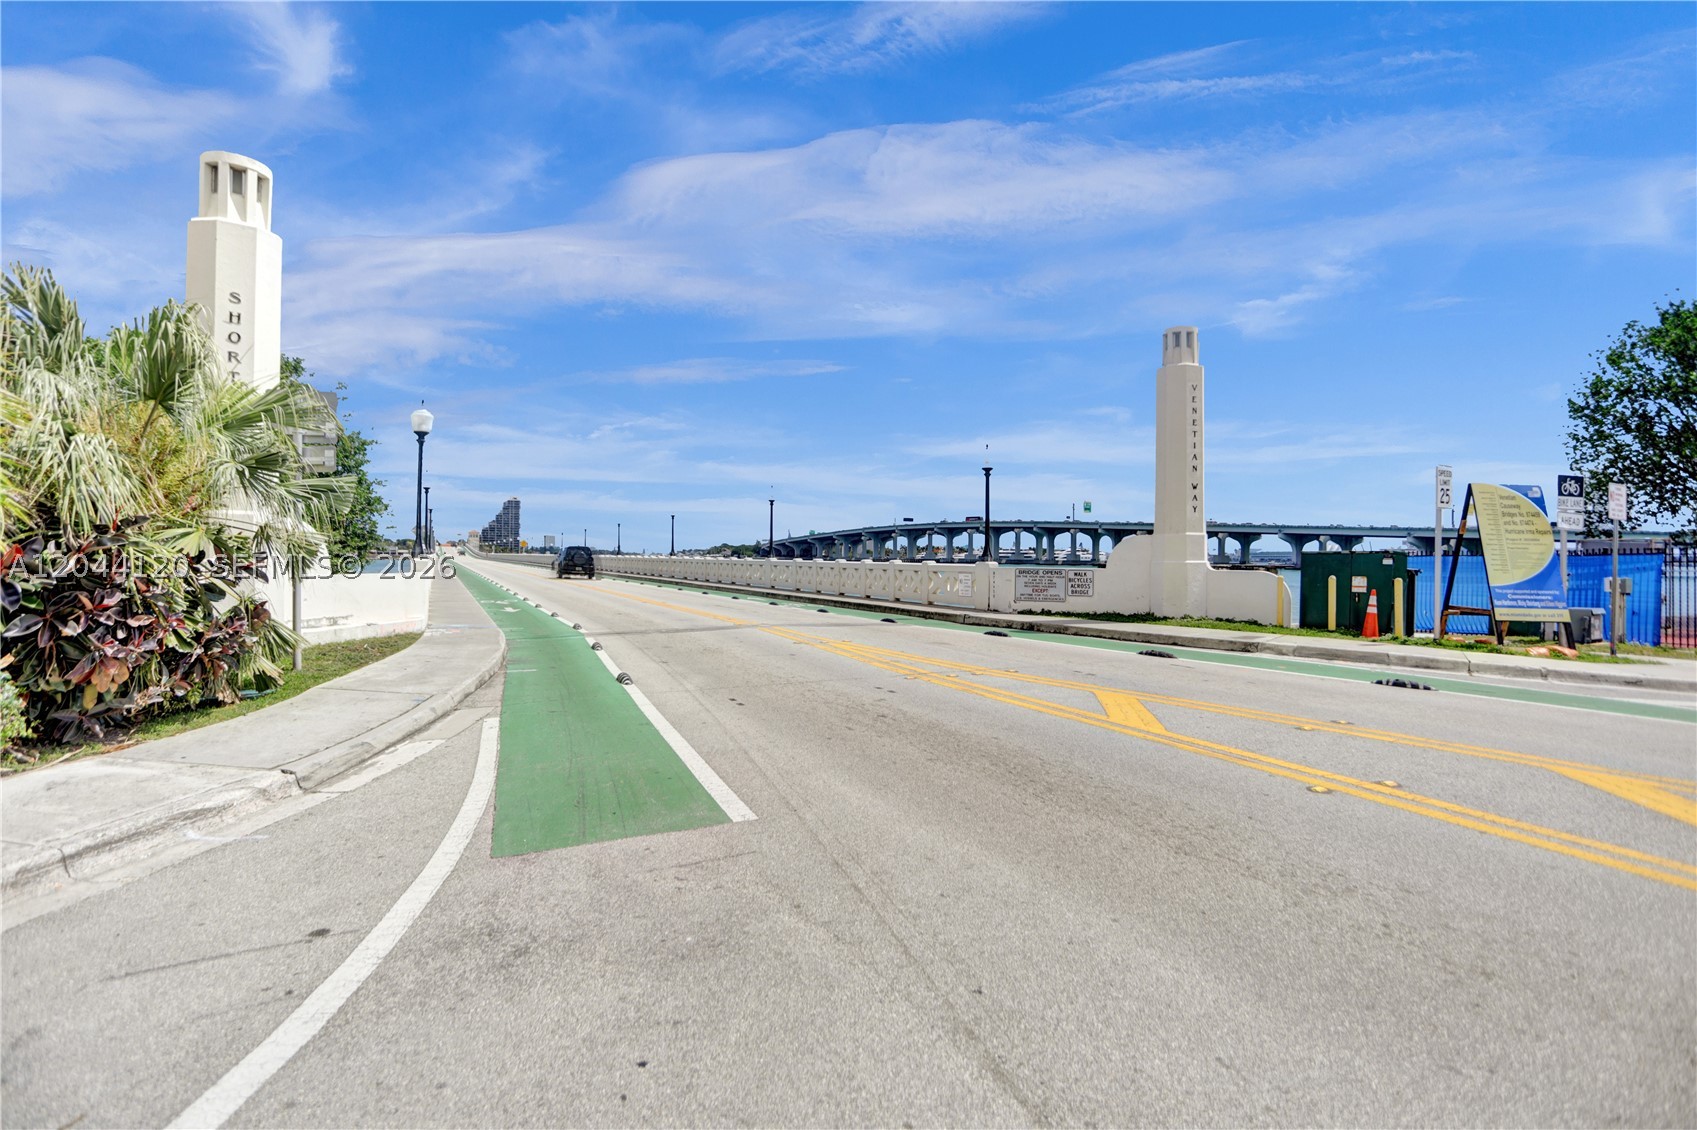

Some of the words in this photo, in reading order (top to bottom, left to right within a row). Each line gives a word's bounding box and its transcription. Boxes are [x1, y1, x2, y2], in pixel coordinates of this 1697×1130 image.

[1191, 482, 1199, 514] WAY
[1440, 488, 1450, 504] 25
[1500, 502, 1521, 510] Causeway
[1558, 498, 1568, 507] BIKE
[1569, 499, 1582, 508] LANE
[1561, 516, 1580, 526] AHEAD
